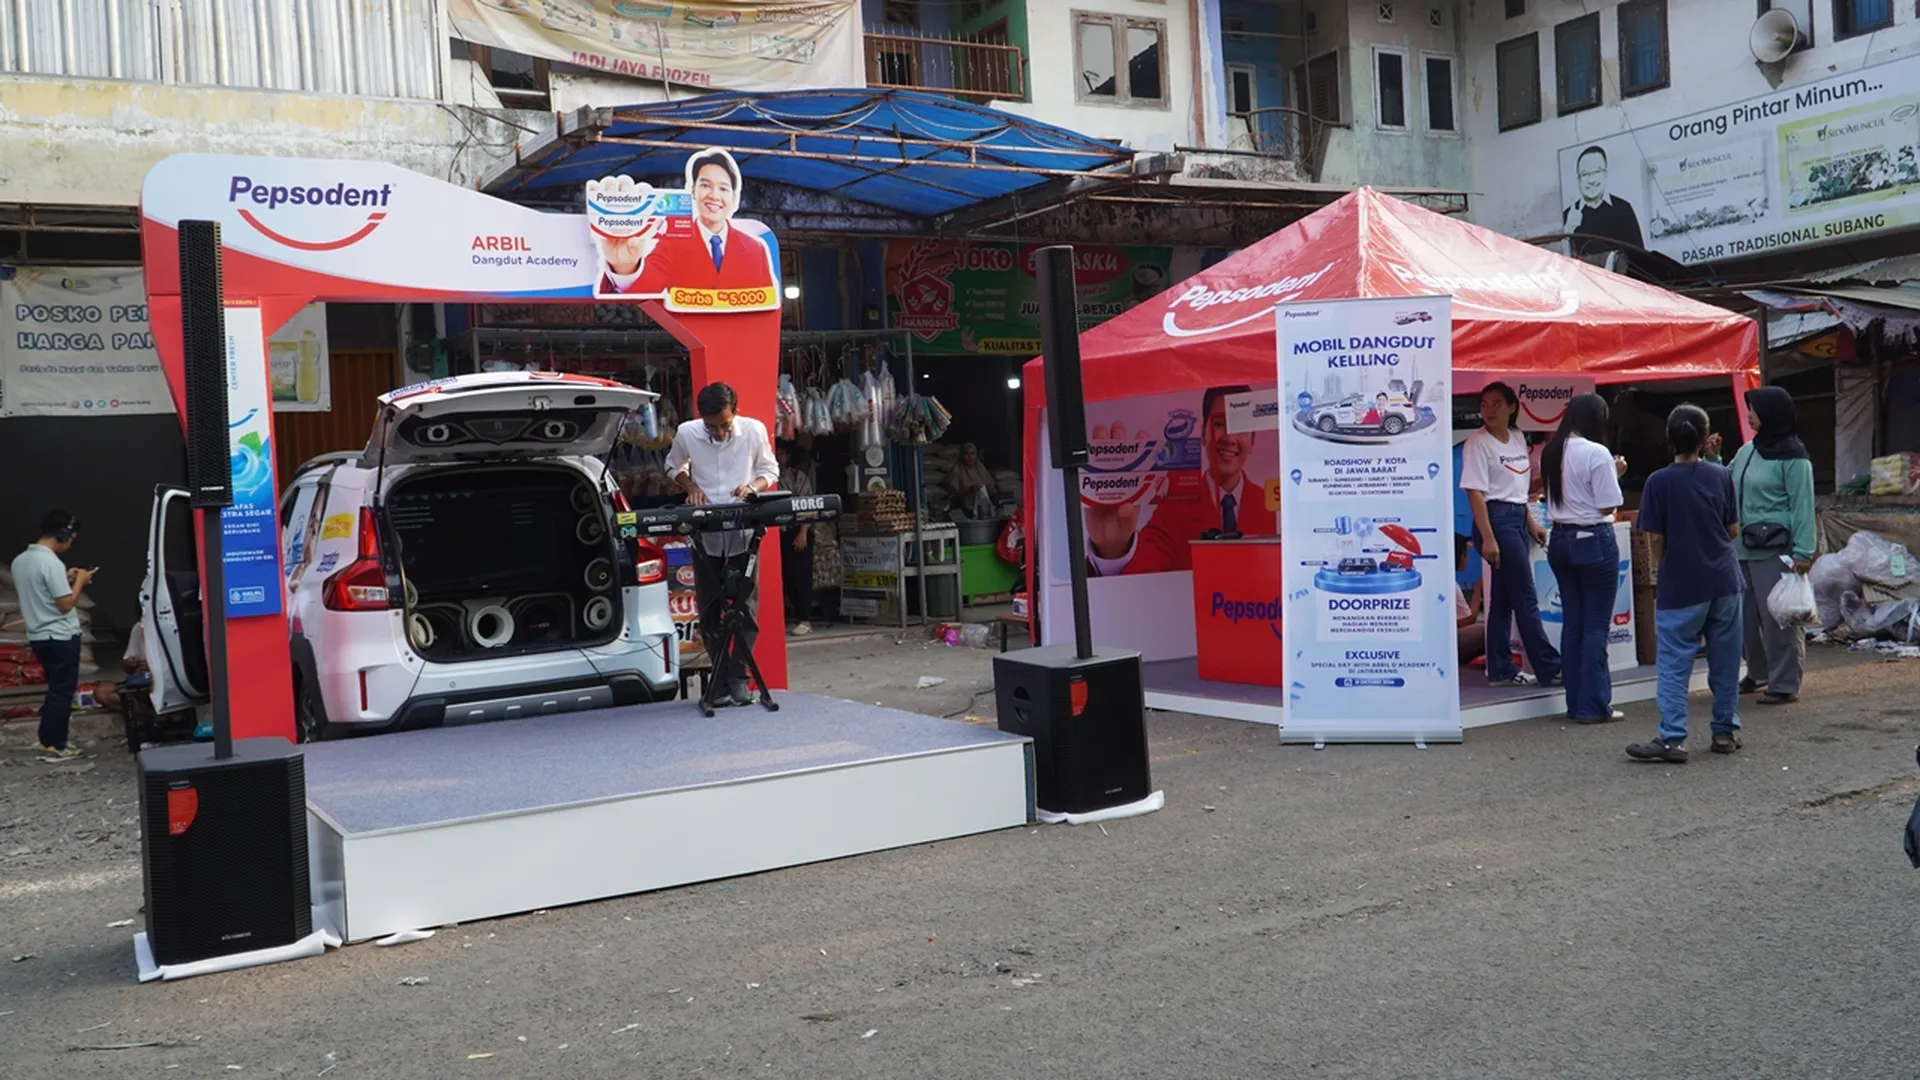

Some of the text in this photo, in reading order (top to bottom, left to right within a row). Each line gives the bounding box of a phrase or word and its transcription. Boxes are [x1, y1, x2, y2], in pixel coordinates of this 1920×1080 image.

[609, 59, 647, 78] JAYA
[1669, 78, 1884, 141] Orang Pintar Minum...
[229, 176, 392, 209] Pepsodent
[596, 193, 642, 204] Pepsodent
[598, 217, 643, 227] Pepsodent
[472, 236, 531, 252] ARBIL
[1682, 213, 1885, 263] PASAR TRADISIONAL SUBANG
[472, 255, 579, 268] Dangdut Academy
[953, 247, 1013, 271] TOKO
[1168, 259, 1336, 311] Pepsodent
[675, 290, 713, 306] Serba
[16, 304, 102, 322] POSKO
[1083, 303, 1122, 316] BERAS
[17, 331, 105, 350] HARGA
[984, 340, 1033, 352] KUALITAS
[1293, 336, 1435, 355] MOBIL DANGDUT
[1327, 353, 1400, 369] KELILING
[1519, 384, 1574, 403] Pepsodent
[1324, 458, 1372, 467] ROADSHOW
[1385, 457, 1407, 465] KOTA
[1334, 466, 1397, 475] DI JAWA BARAT
[1082, 476, 1140, 491] Pepsodent
[792, 497, 824, 511] KORG
[245, 509, 272, 517] SEGAR
[1328, 598, 1411, 611] DOORPRIZE
[1345, 650, 1400, 660] EXCLUSIVE
